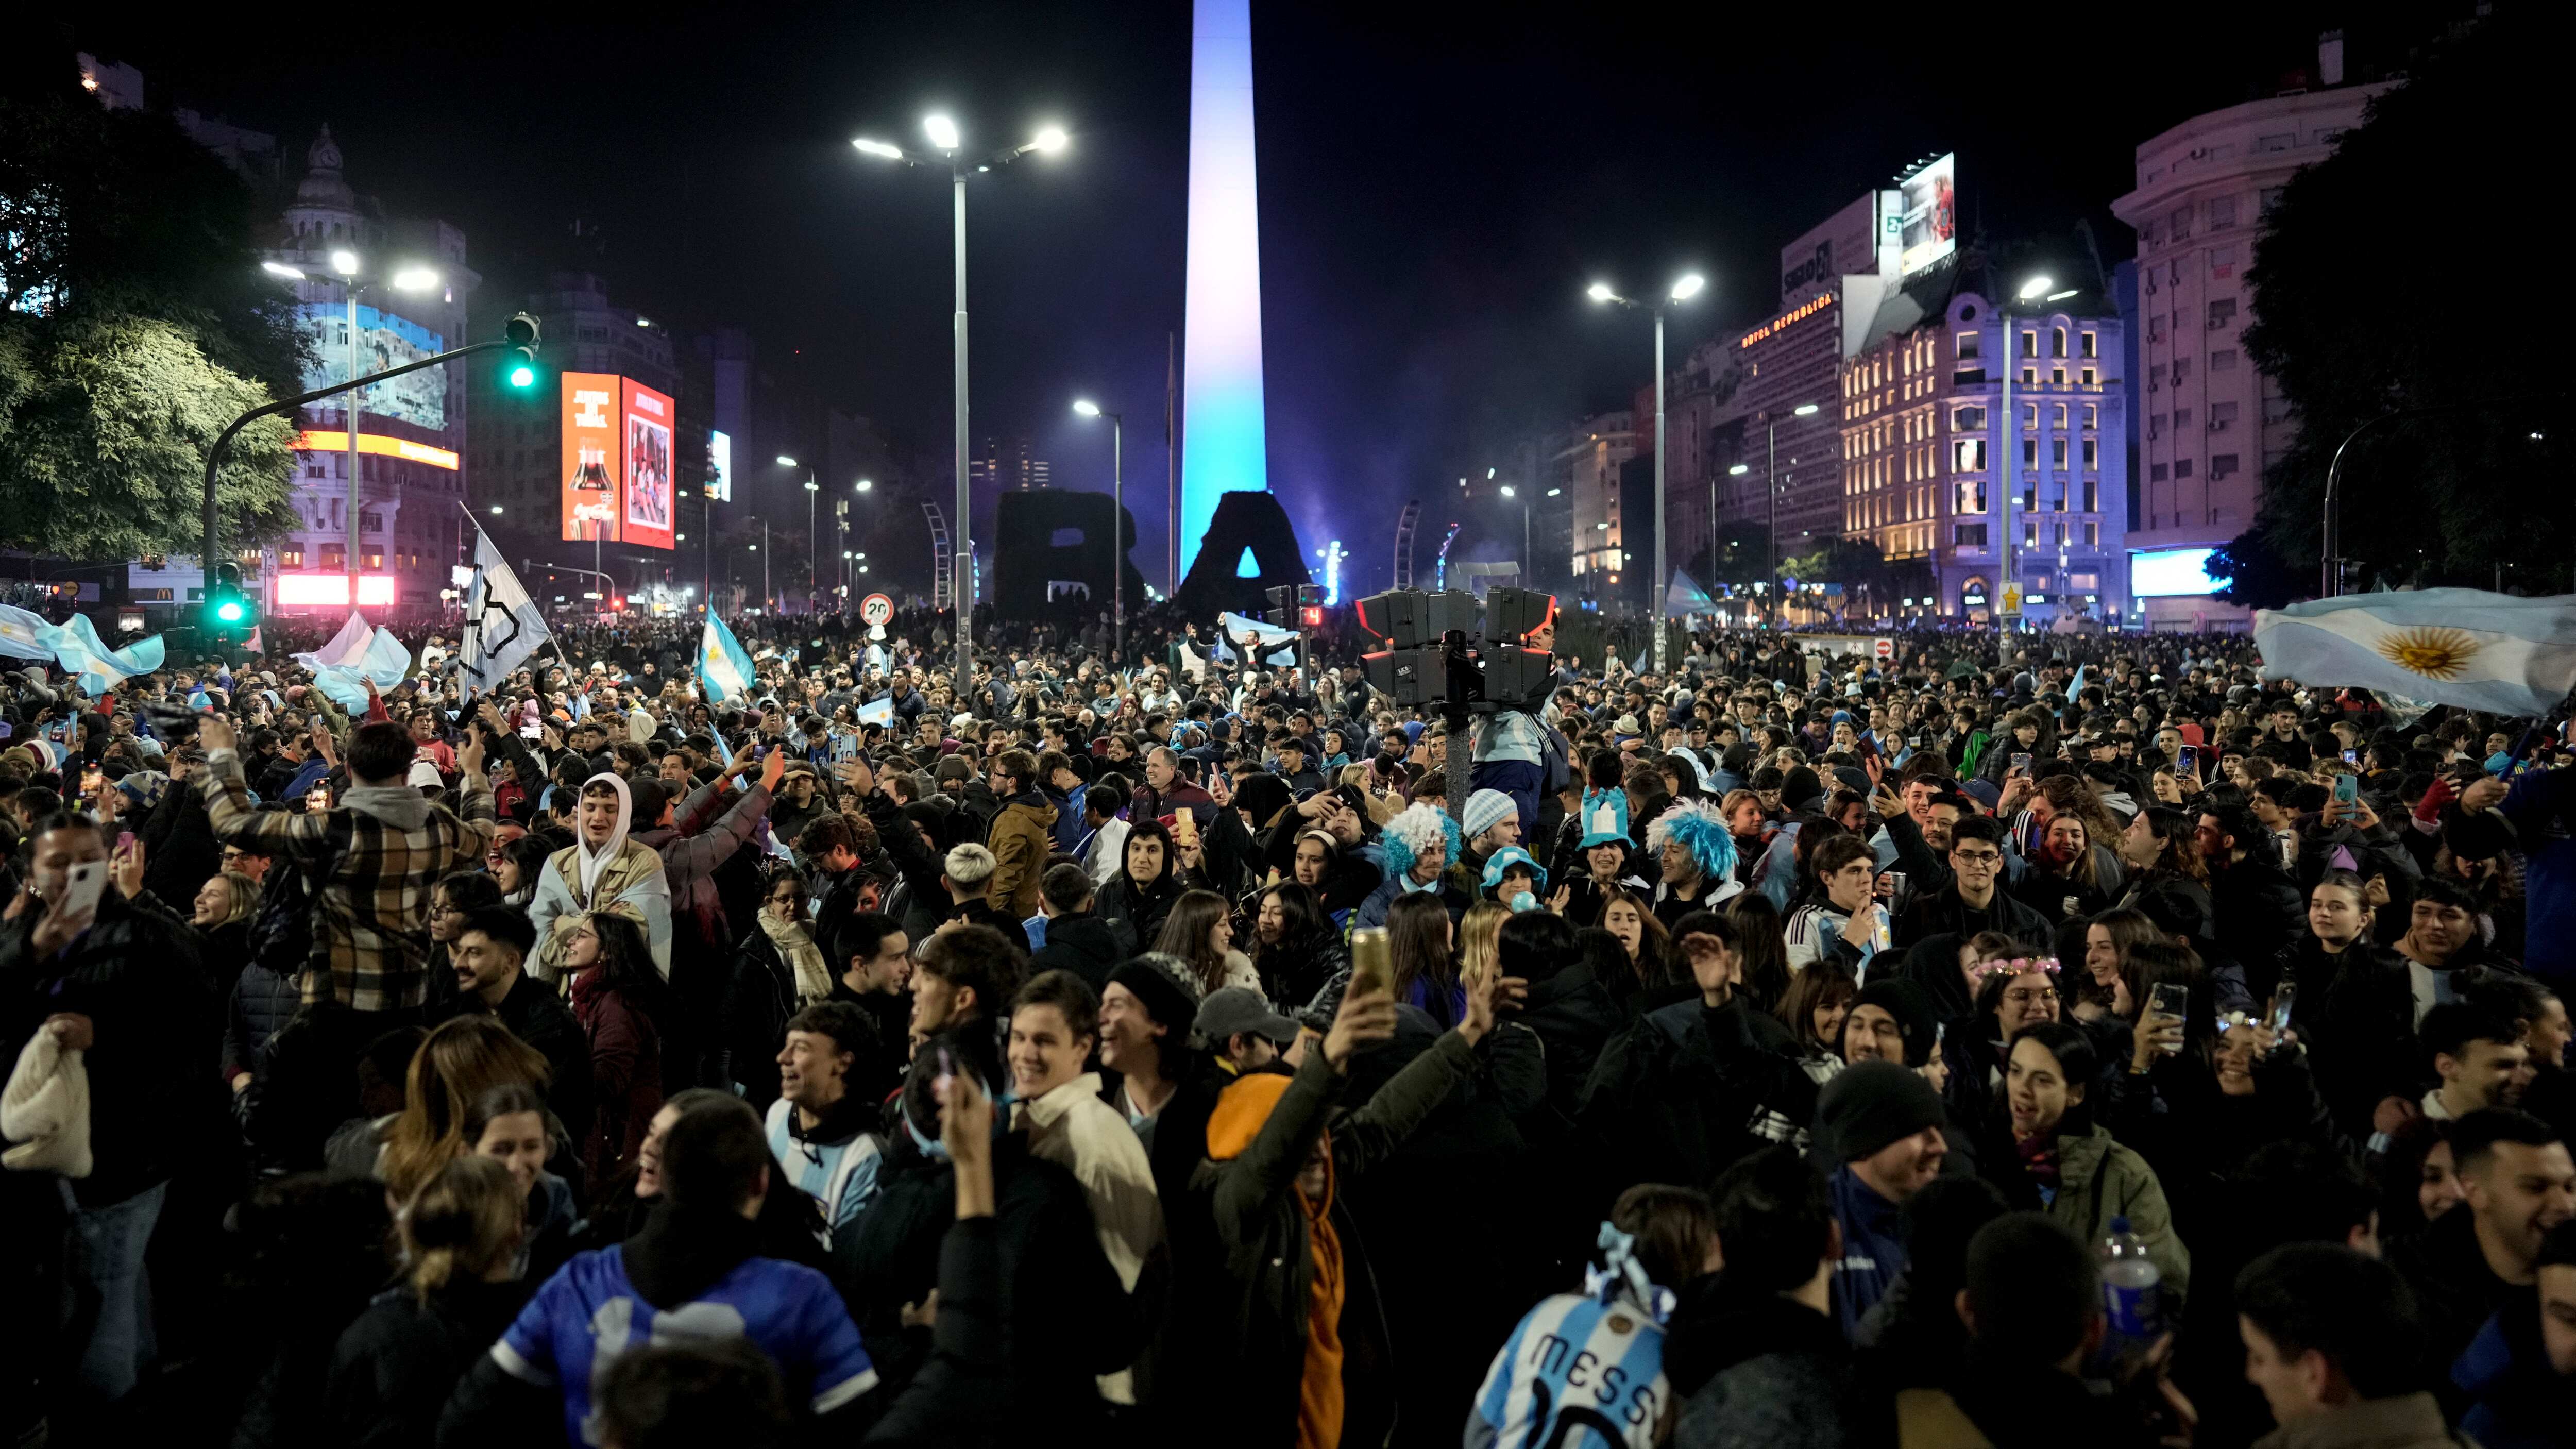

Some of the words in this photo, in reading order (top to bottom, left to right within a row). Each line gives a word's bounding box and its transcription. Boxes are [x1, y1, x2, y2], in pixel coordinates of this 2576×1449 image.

[1742, 326, 1770, 348] HOTEL
[1774, 294, 1831, 331] REPUBLICA
[869, 603, 887, 616] 20
[1530, 1333, 1656, 1426] MESS
